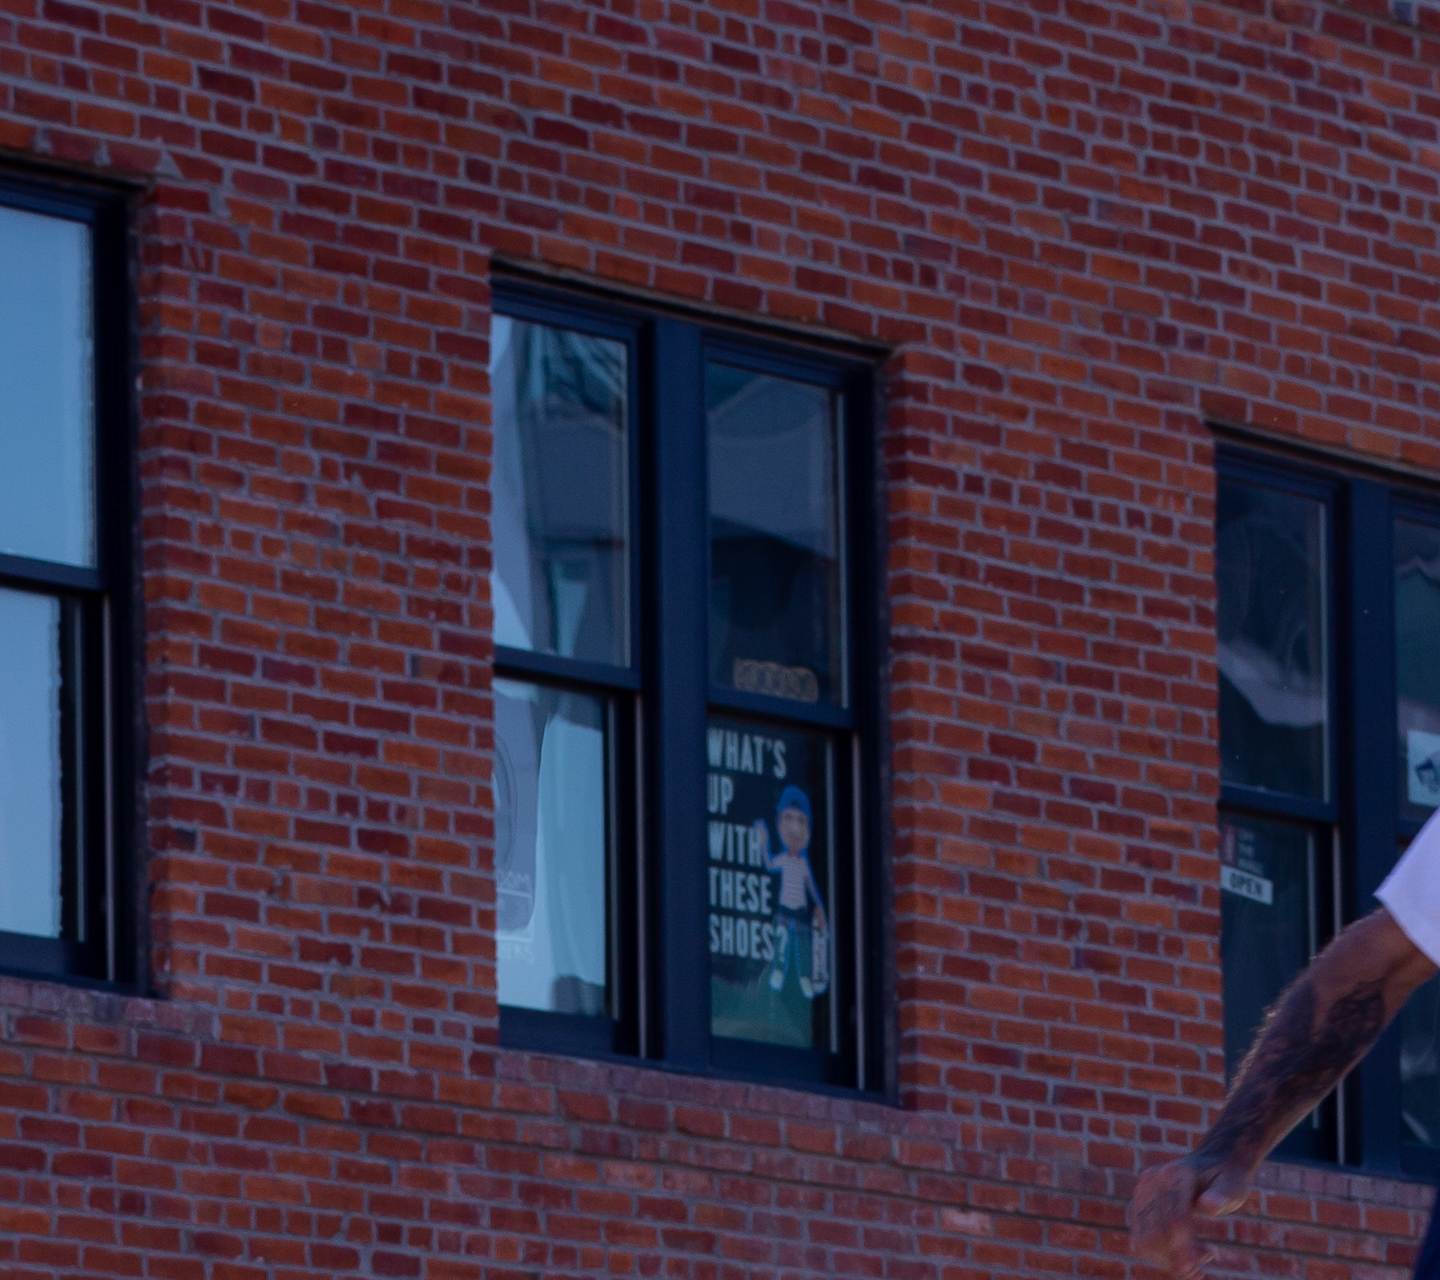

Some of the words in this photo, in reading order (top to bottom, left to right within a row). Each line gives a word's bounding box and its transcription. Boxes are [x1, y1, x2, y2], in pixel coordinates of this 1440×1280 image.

[708, 727, 787, 779] WHAT'S
[708, 774, 734, 815] UP
[708, 820, 762, 867] WITH
[708, 866, 773, 916] THESE
[709, 914, 789, 964] SHOES?
